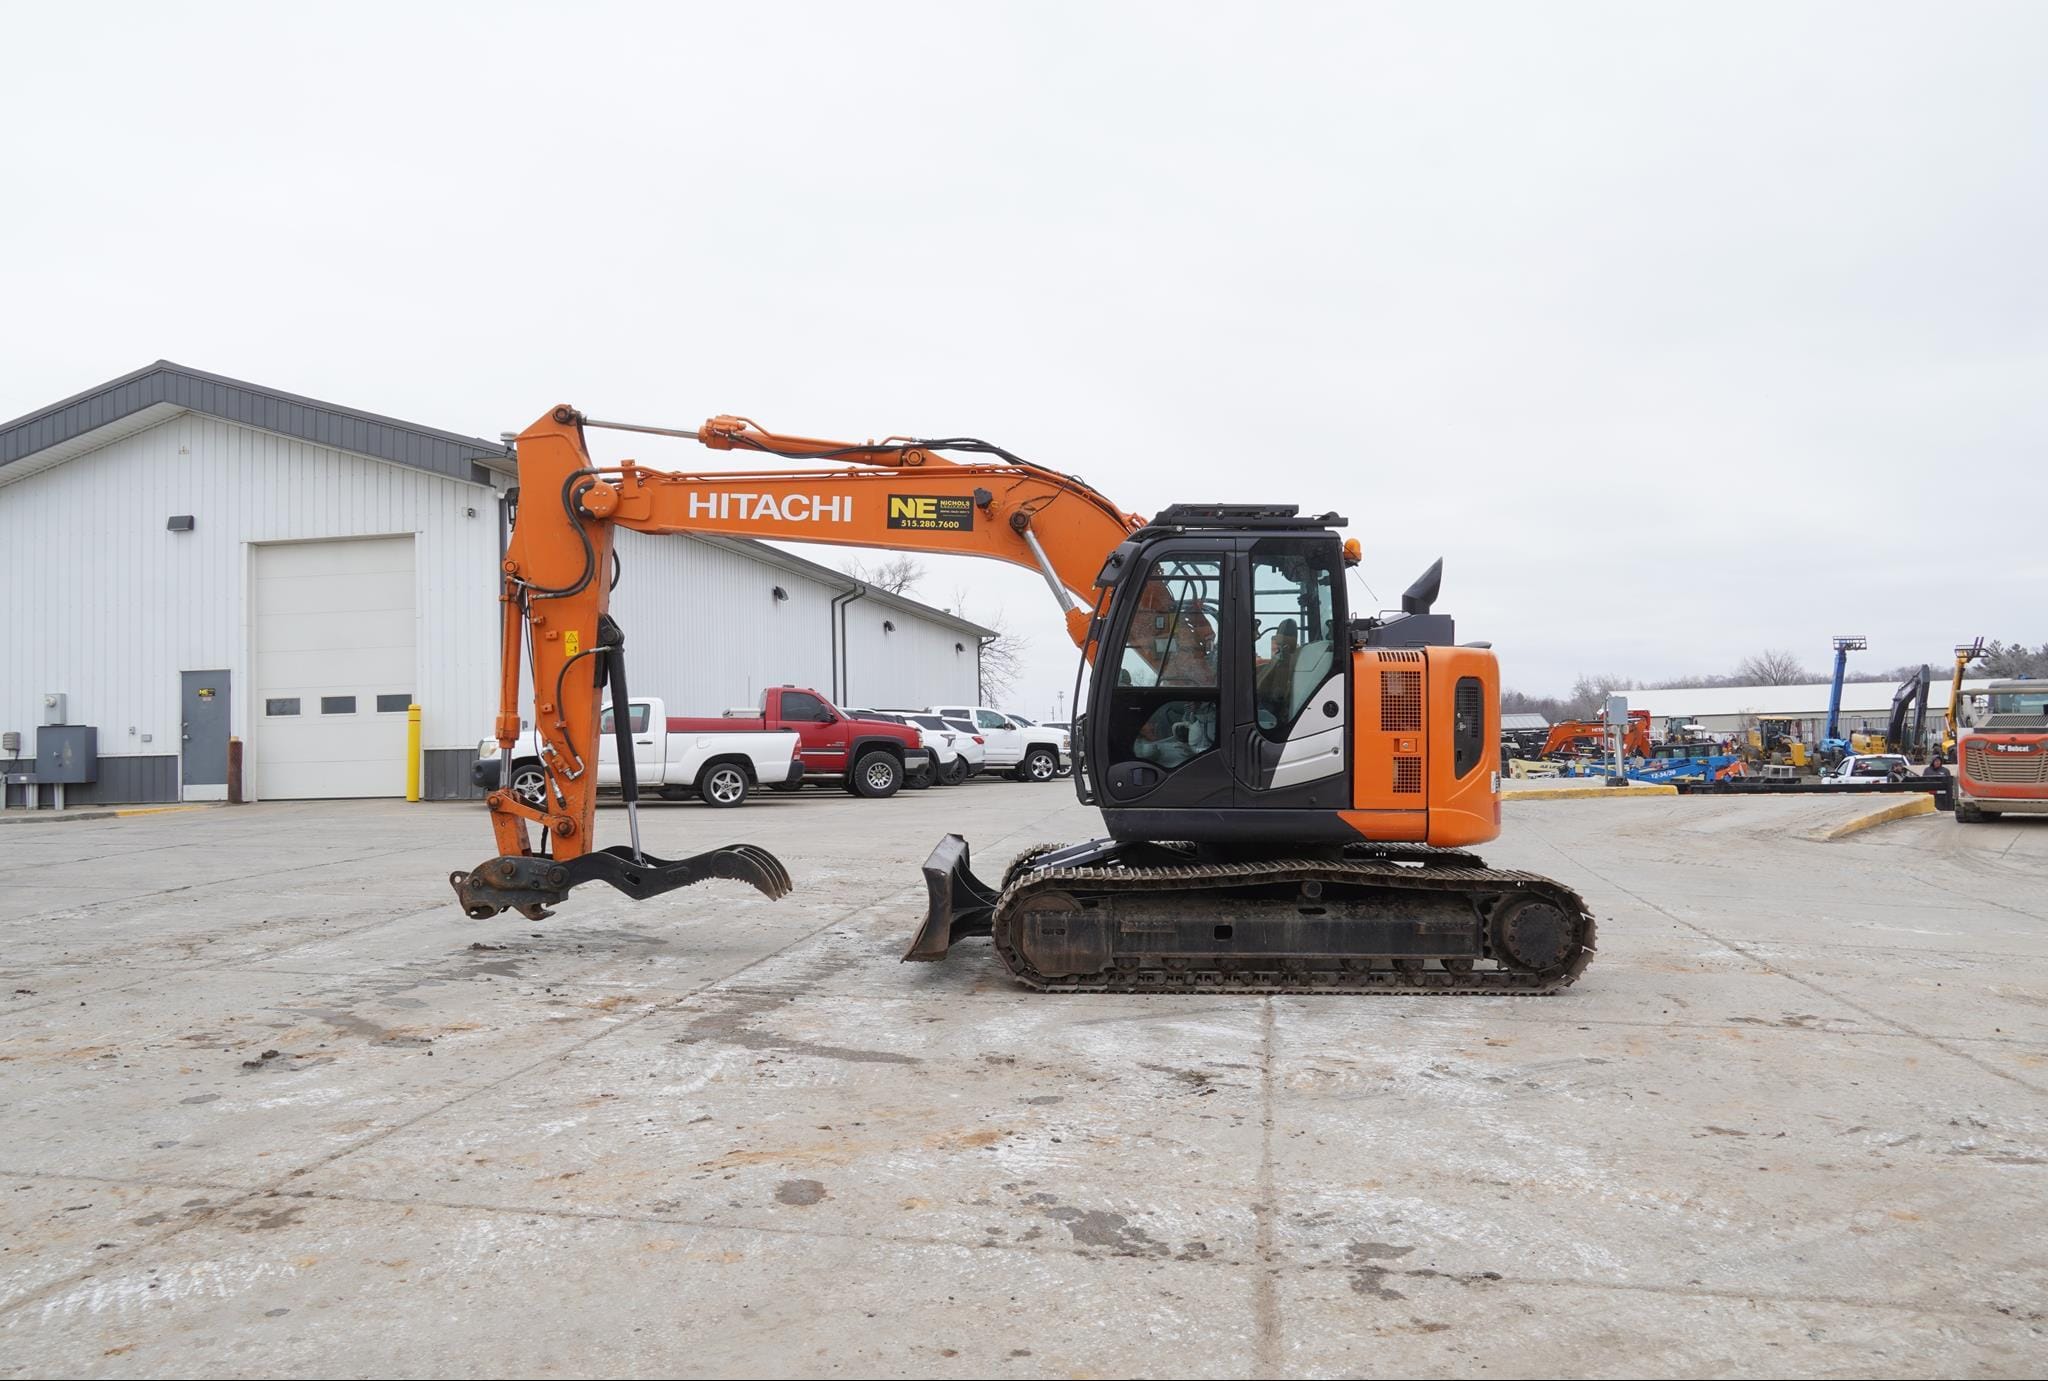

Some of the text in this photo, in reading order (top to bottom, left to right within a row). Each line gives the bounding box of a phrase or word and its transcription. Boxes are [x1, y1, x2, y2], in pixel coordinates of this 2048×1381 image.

[689, 492, 852, 522] HITACHI
[891, 497, 937, 519] NE
[901, 520, 960, 529] 515.280.7600
[2007, 744, 2029, 752] Bobcat
